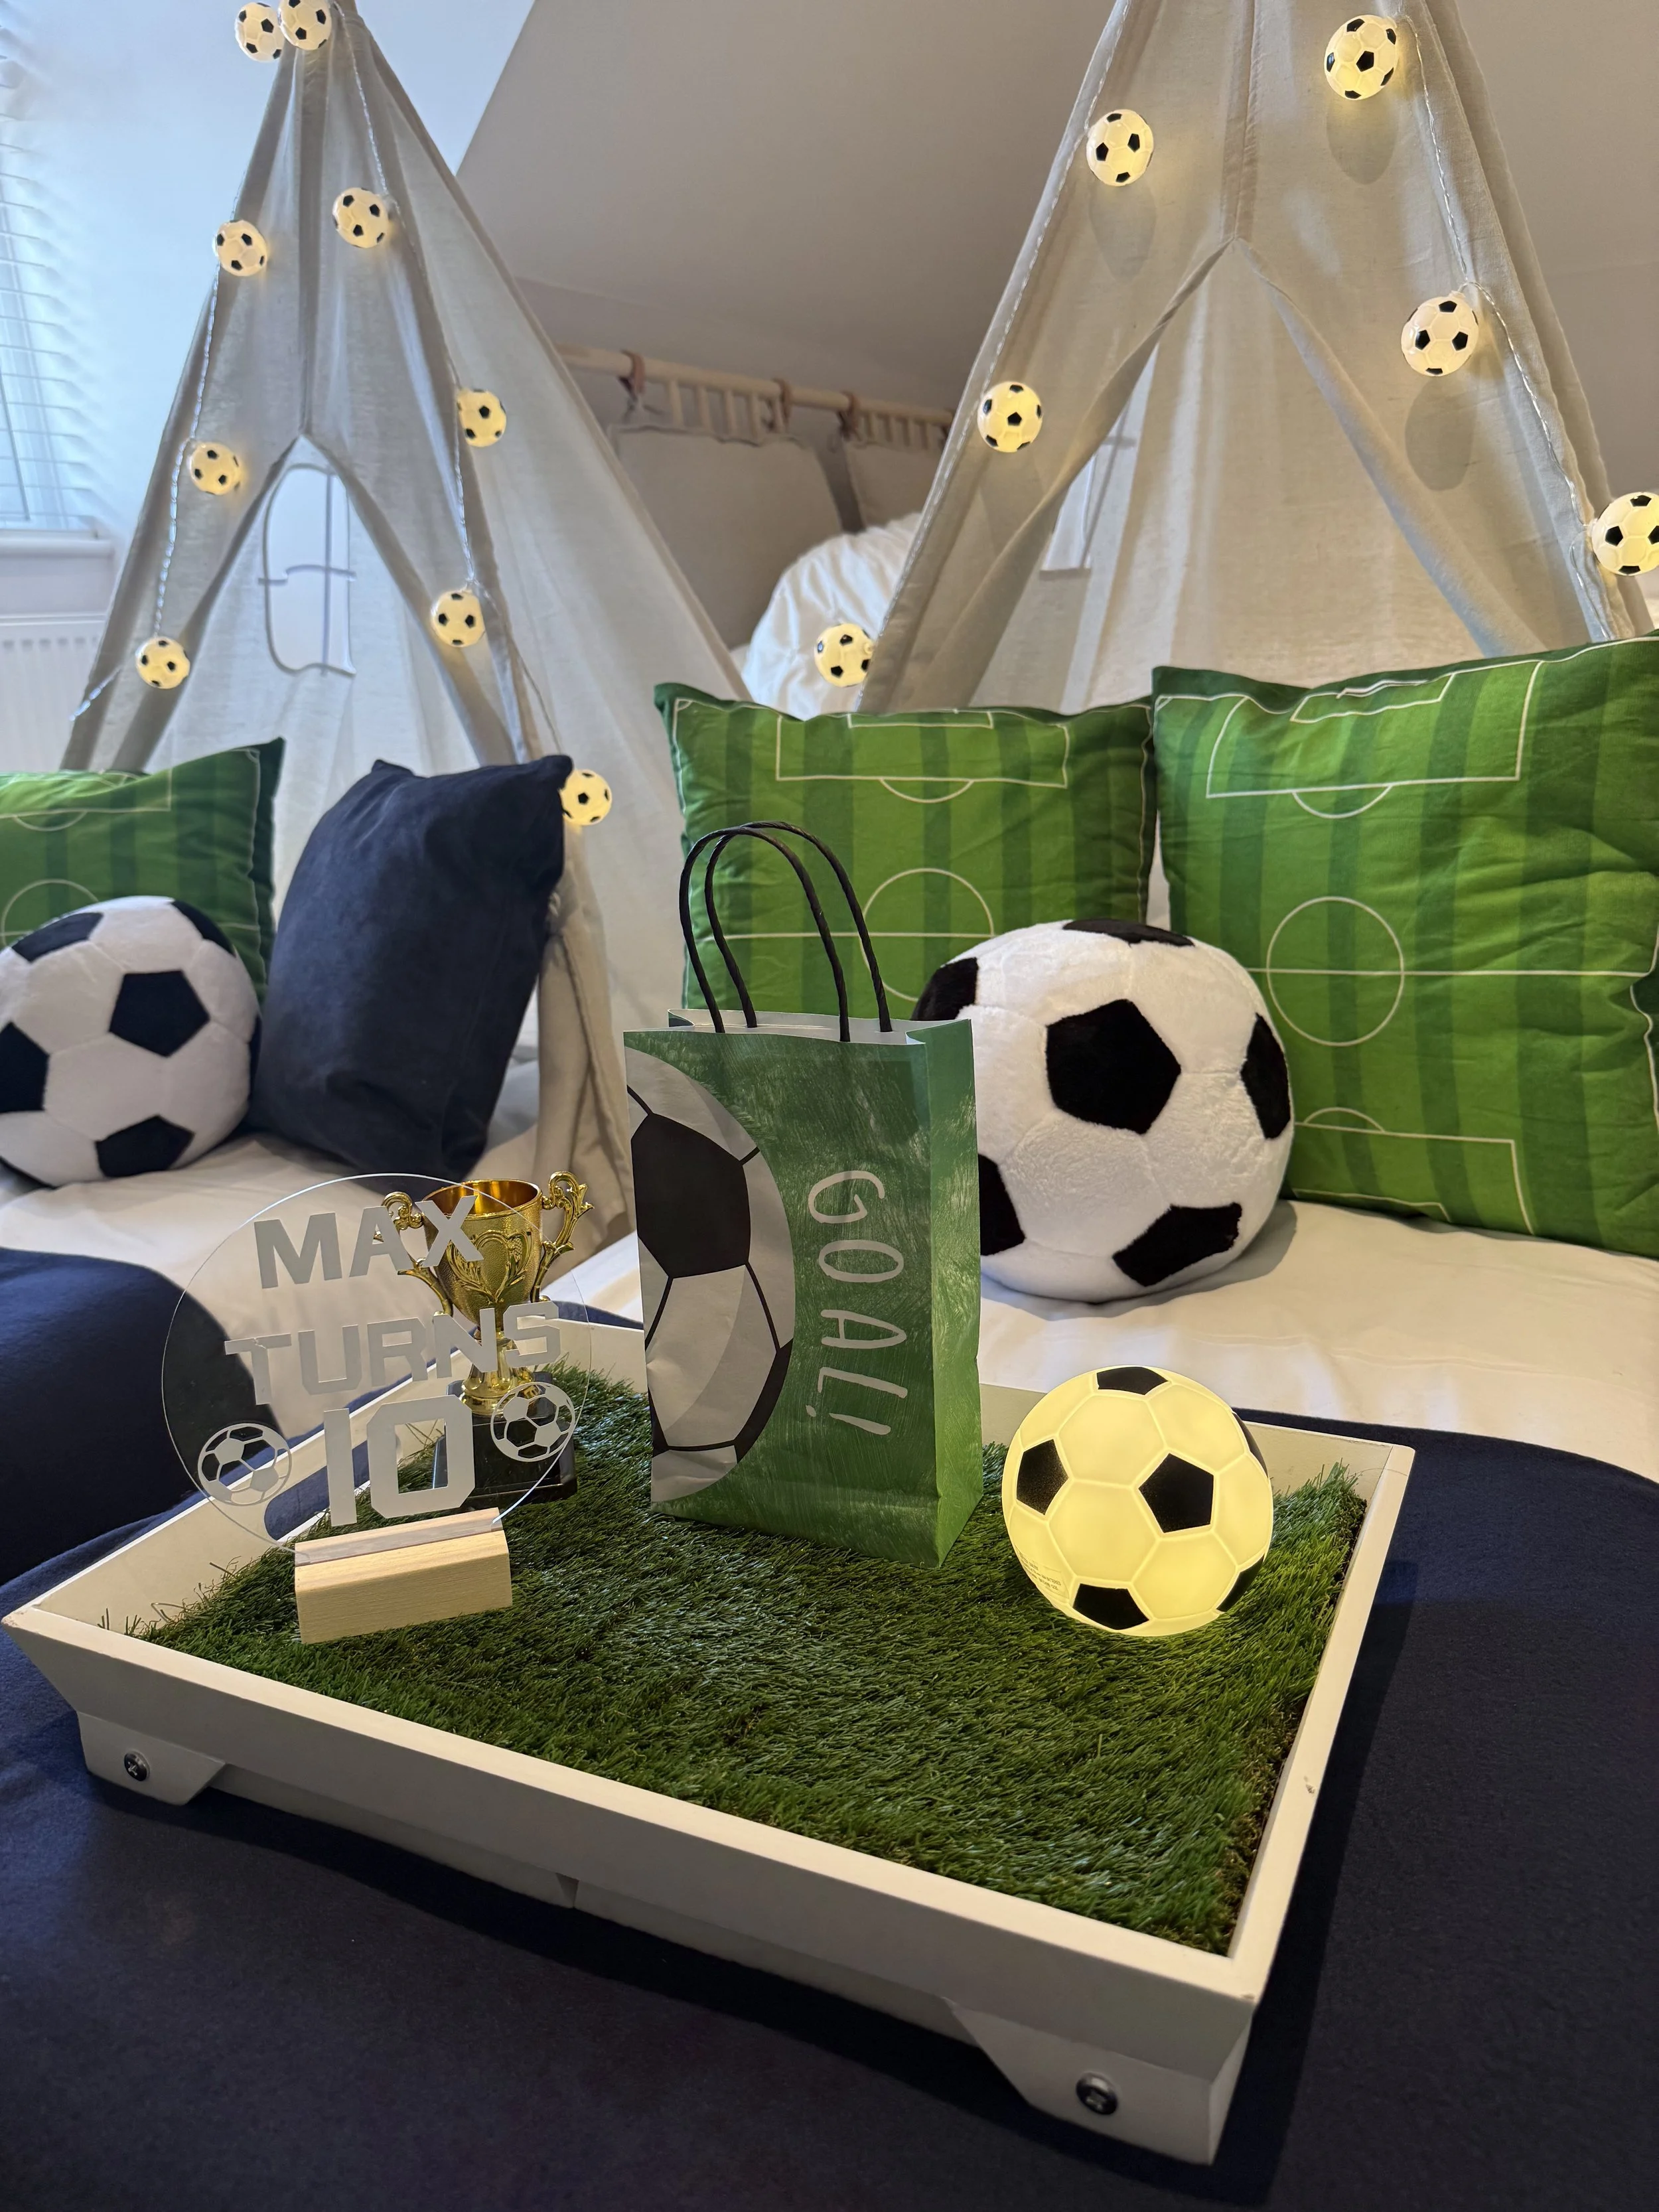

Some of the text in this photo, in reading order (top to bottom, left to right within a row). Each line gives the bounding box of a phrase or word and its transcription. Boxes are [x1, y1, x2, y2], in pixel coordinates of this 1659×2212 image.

[253, 1195, 484, 1290] MAX
[224, 1301, 562, 1406] TURNS
[805, 1170, 908, 1436] GOAL!
[324, 1394, 475, 1527] 10
